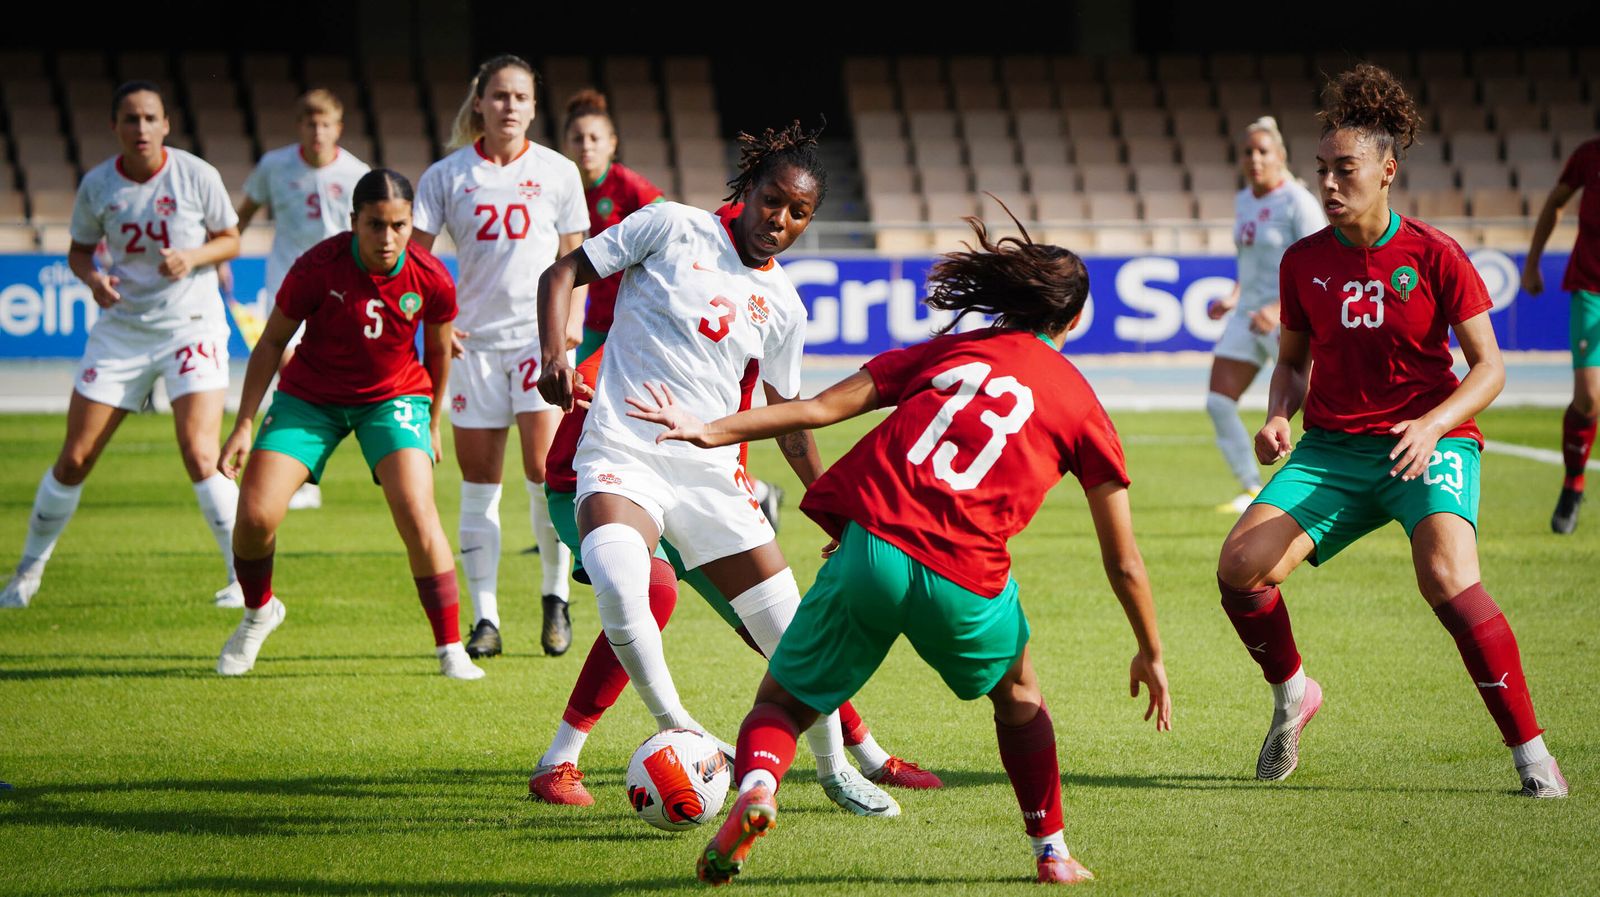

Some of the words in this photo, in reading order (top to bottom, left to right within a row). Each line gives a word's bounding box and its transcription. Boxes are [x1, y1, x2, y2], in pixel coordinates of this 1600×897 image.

[121, 220, 170, 254] 24
[474, 203, 531, 241] 20
[364, 299, 385, 339] 5
[698, 295, 736, 343] 3
[748, 298, 769, 320] CANADA
[1341, 280, 1384, 328] 23
[175, 342, 219, 375] 24
[907, 361, 1035, 491] 13
[1423, 450, 1463, 490] 23
